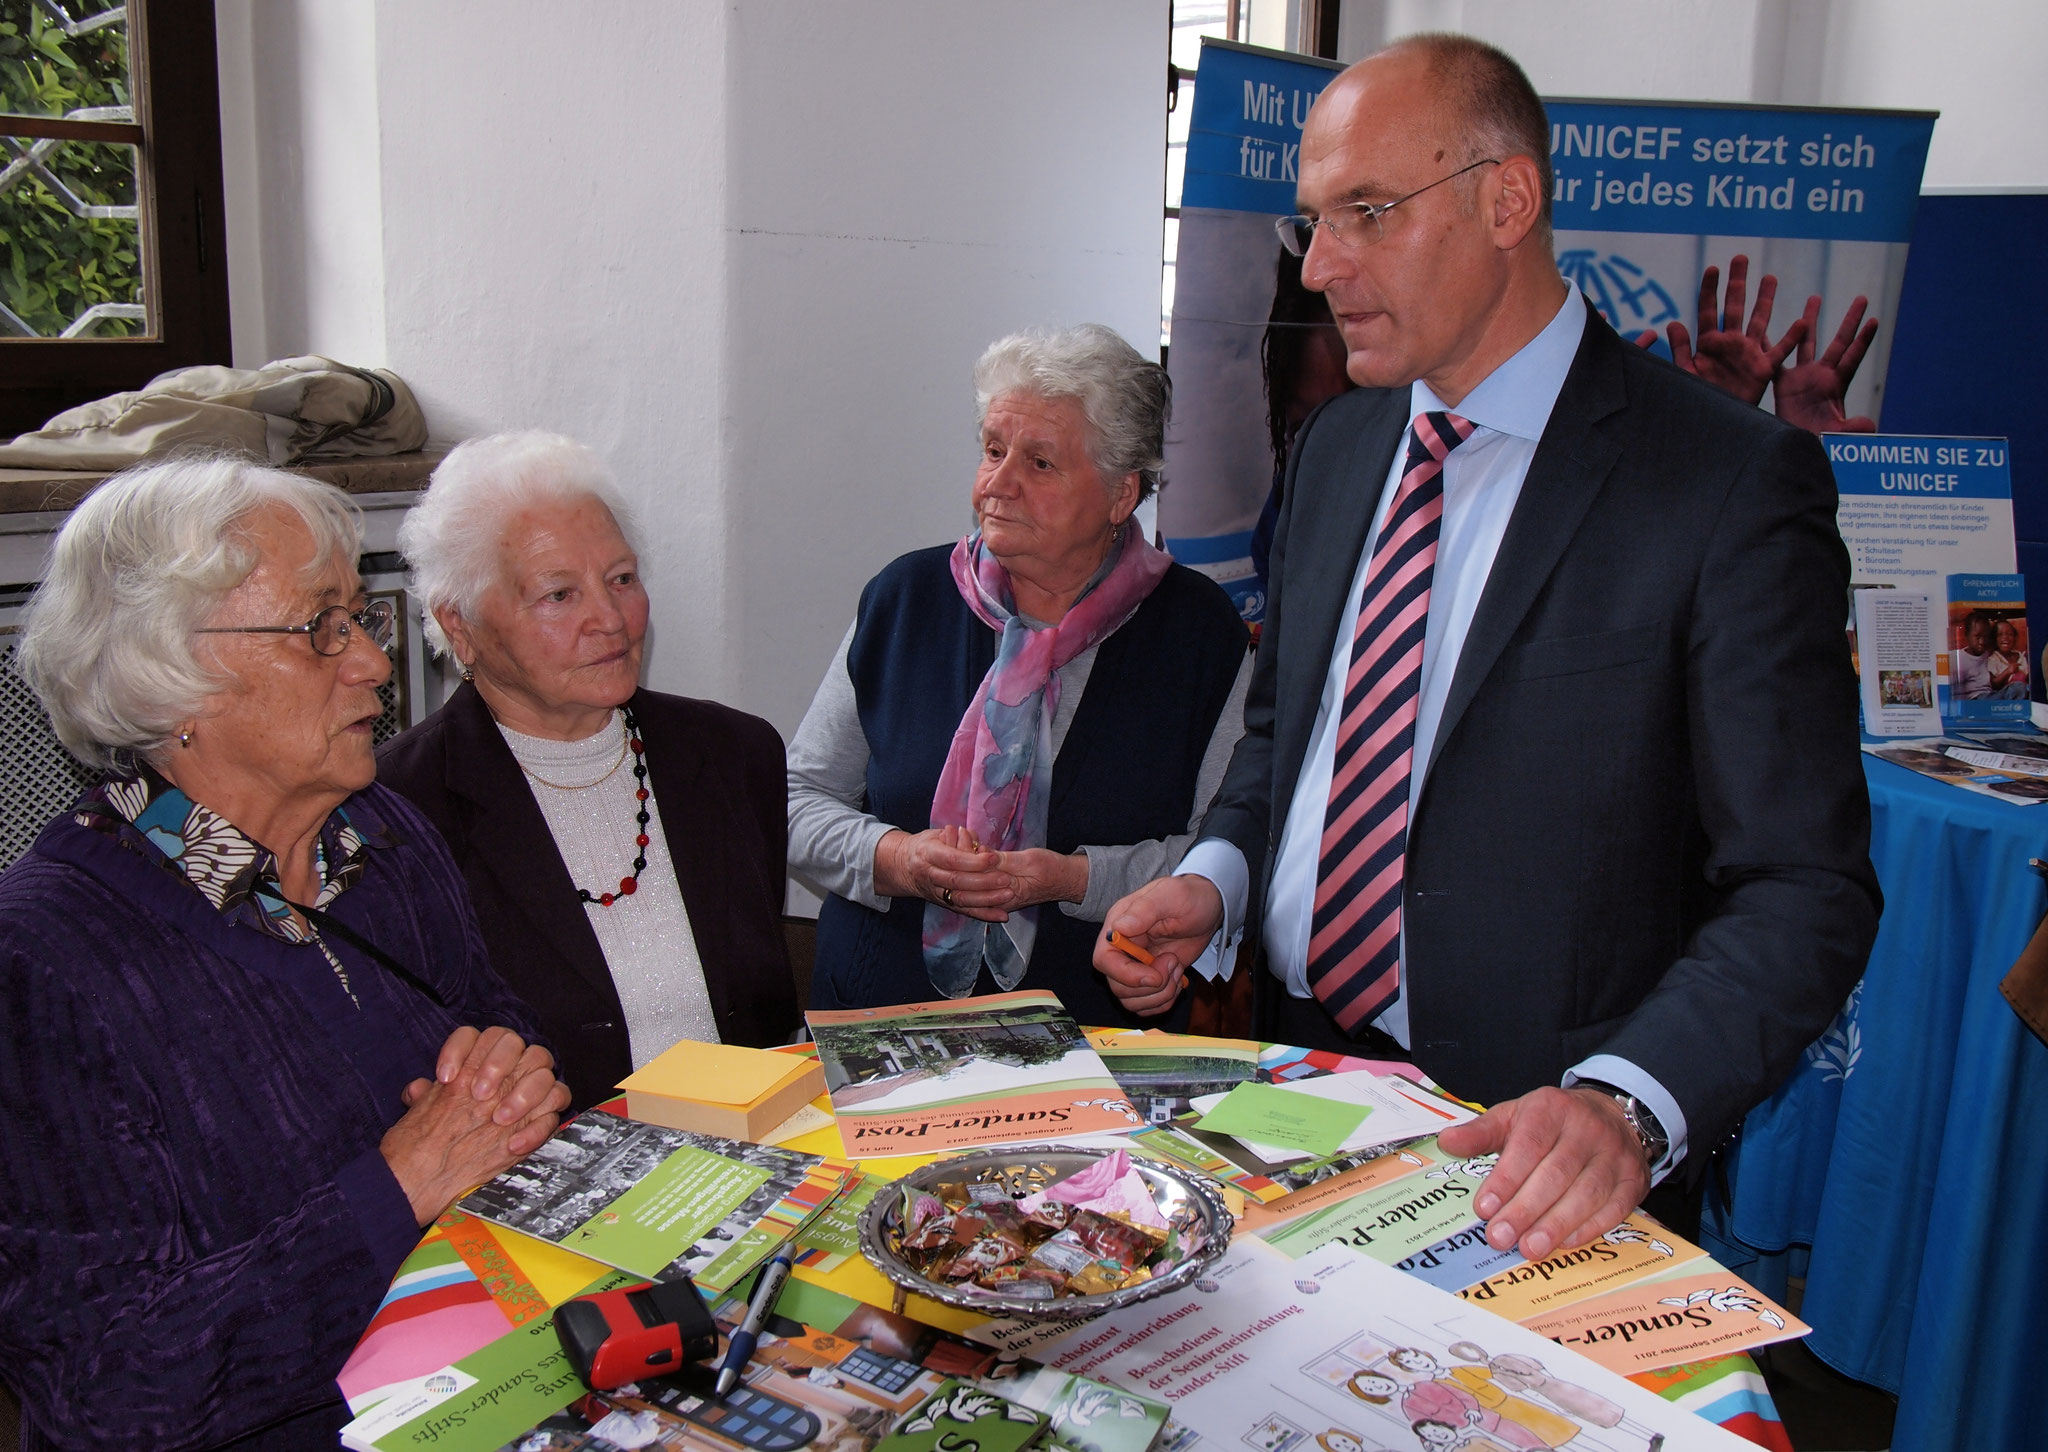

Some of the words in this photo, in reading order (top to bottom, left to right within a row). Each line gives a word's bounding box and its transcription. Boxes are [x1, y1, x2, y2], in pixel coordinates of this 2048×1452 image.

[1243, 79, 1285, 127] Mit
[1292, 89, 1321, 130] U
[1240, 136, 1275, 178] für
[1281, 142, 1299, 183] K
[1692, 134, 1789, 165] setzt
[1799, 134, 1876, 168] sich
[1552, 169, 1582, 202] ür
[1591, 171, 1694, 211] jedes
[1706, 174, 1796, 211] Kind
[1807, 179, 1865, 213] ein
[1829, 443, 1930, 465] KOMMEN
[1936, 447, 1969, 466] SIE
[1975, 448, 2005, 467] ZU
[1880, 472, 1960, 492] UNICEF
[1852, 501, 1883, 510] möchten
[1885, 501, 1899, 510] sich
[1900, 502, 1948, 511] ehrenamtlich
[1948, 503, 1960, 512] für
[1961, 503, 1984, 512] Kinder
[1883, 512, 1898, 520] Ihre
[1899, 513, 1928, 522] eigenen
[1929, 513, 1950, 521] Ideen
[1951, 514, 1990, 523] einbringen
[1839, 521, 1854, 529] und
[1855, 522, 1898, 531] gemeinsam
[1950, 524, 1987, 533] bewegen?
[1855, 536, 1881, 545] suchen
[1881, 537, 1925, 547] Verstärkung
[1926, 538, 1937, 546] für
[1864, 547, 1903, 555] Schulteam
[1865, 556, 1901, 565] Büroteam
[1866, 567, 1937, 577] Veranstaltungsteam
[1977, 589, 1999, 598] AKTIV
[938, 1109, 1000, 1118] Hauszeitung
[855, 1107, 1072, 1140] Sander-Post
[972, 1131, 1022, 1141] September
[1337, 1176, 1362, 1192] August
[1362, 1173, 1377, 1183] Juli
[691, 1175, 742, 1219] Augsburger
[721, 1172, 763, 1207] Augsburg
[1298, 1186, 1338, 1208] September
[1367, 1186, 1415, 1209] Hauszeitung
[656, 1165, 740, 1232] Freiwilligen-Messe
[1276, 1203, 1297, 1214] 2012
[1306, 1178, 1470, 1256] Sander-P
[1353, 1204, 1369, 1215] des
[1437, 1220, 1451, 1229] Mai
[1449, 1212, 1466, 1224] April
[1405, 1231, 1424, 1245] 2012
[1423, 1225, 1437, 1236] Juni
[1473, 1256, 1492, 1270] 2012
[1494, 1250, 1512, 1262] März
[1634, 1255, 1666, 1272] Oktober
[1596, 1265, 1635, 1285] November
[600, 1276, 627, 1293] Heft
[1553, 1279, 1594, 1298] Dezember
[1530, 1293, 1551, 1306] 2011
[1568, 1314, 1584, 1324] des
[1585, 1303, 1648, 1321] Hauszeitung
[529, 1319, 554, 1336] 010
[1007, 1335, 1033, 1352] der
[1033, 1310, 1107, 1342] Seniore
[1748, 1325, 1762, 1336] Juli
[1068, 1300, 1204, 1378] Senioreneinrichtung
[1721, 1329, 1748, 1344] August
[1051, 1324, 1123, 1370] uchsdienst
[1128, 1324, 1224, 1380] Besuchsdienst
[1148, 1372, 1174, 1391] der
[1171, 1303, 1305, 1377] Senioreneinrichtung
[1659, 1338, 1717, 1356] September
[1633, 1350, 1658, 1362] 2011
[534, 1372, 578, 1398] ung
[1164, 1351, 1251, 1402] Sander-Stift
[412, 1368, 539, 1444] Sander-Stifts
